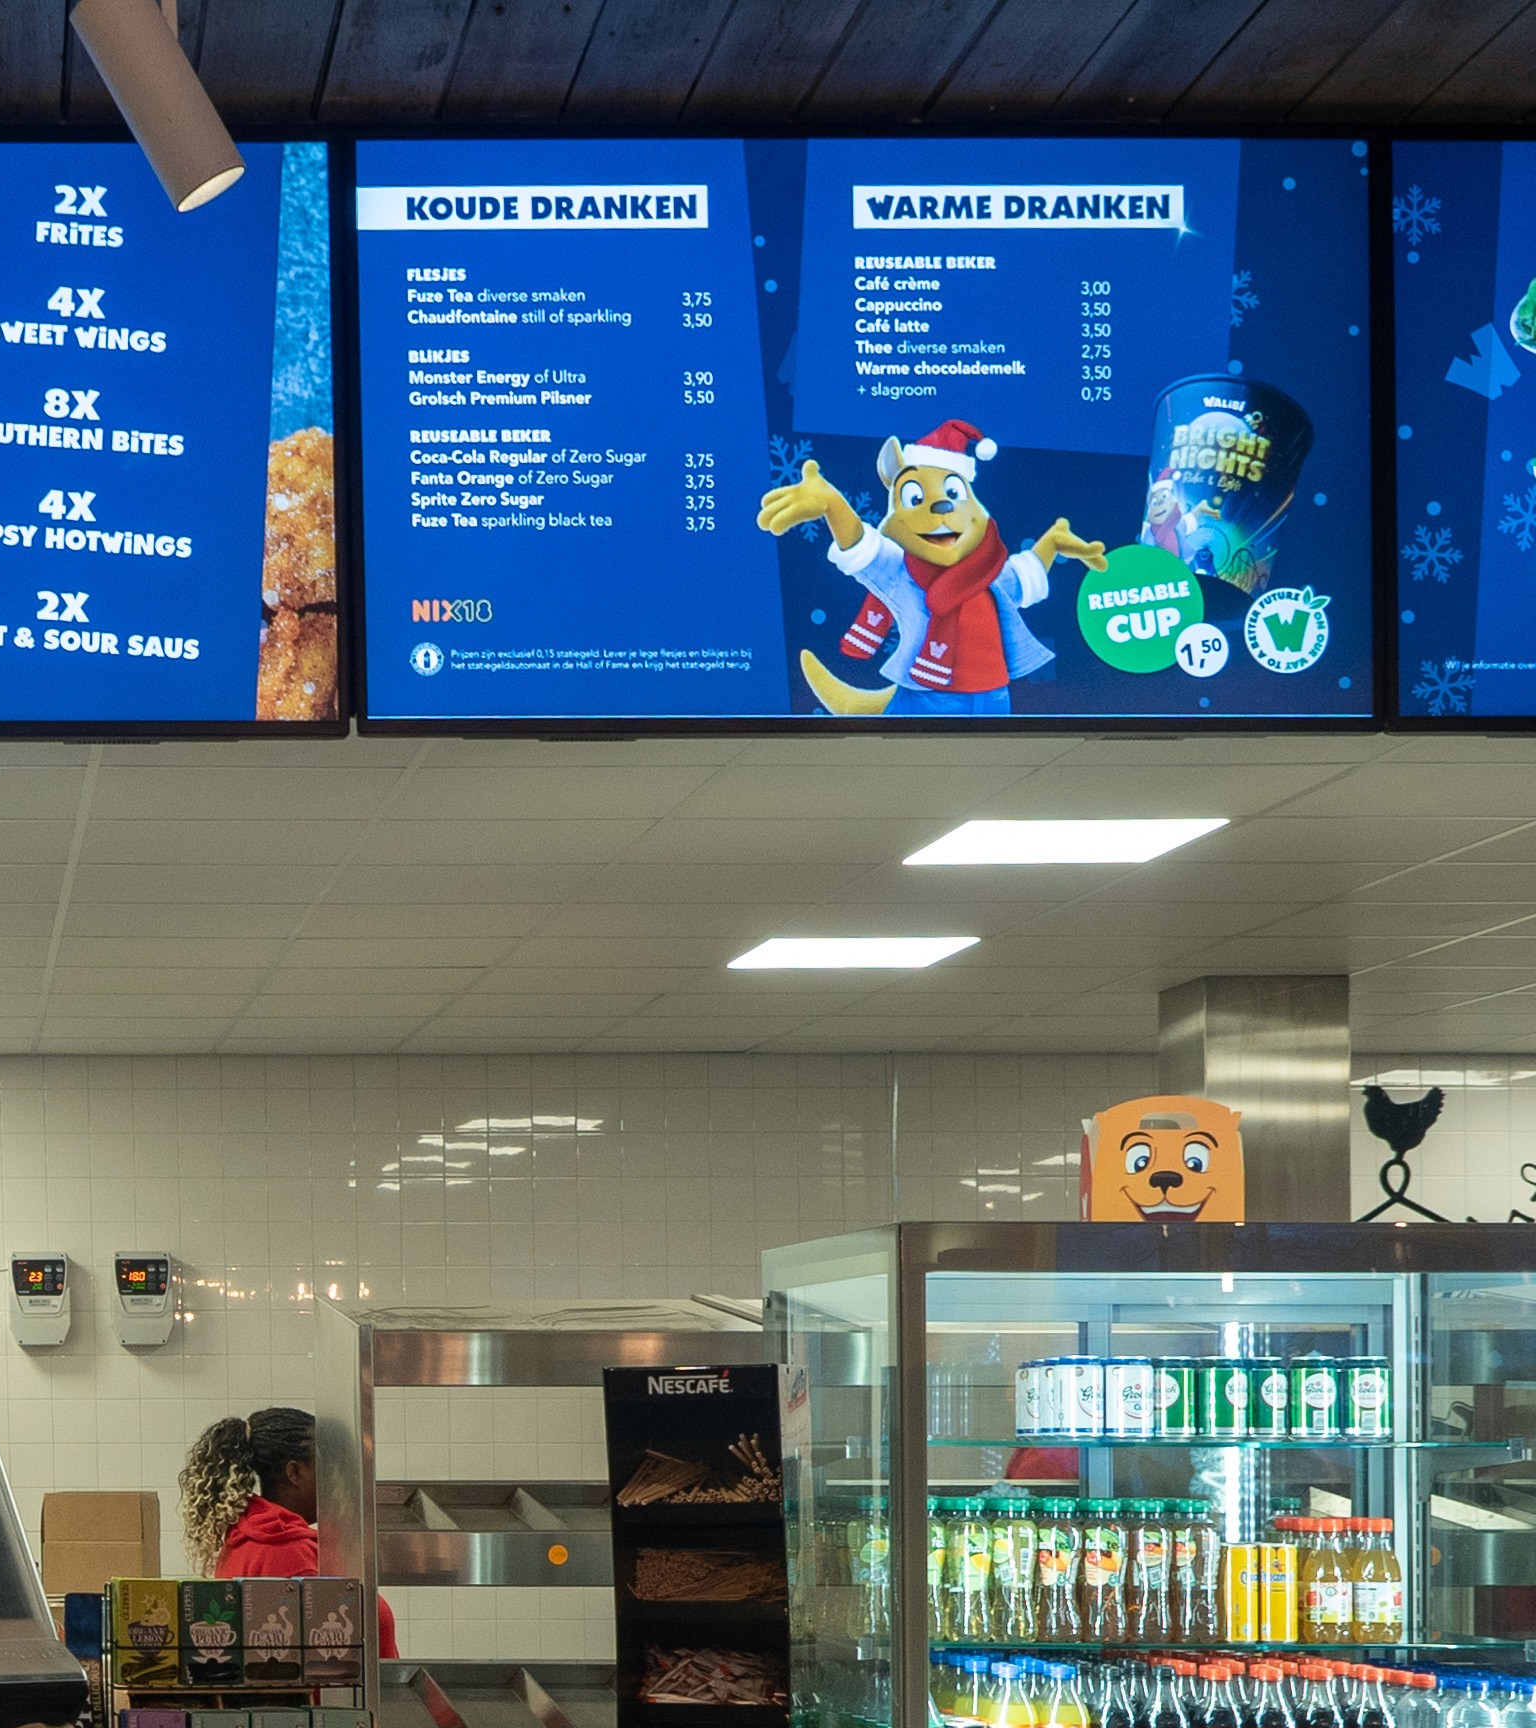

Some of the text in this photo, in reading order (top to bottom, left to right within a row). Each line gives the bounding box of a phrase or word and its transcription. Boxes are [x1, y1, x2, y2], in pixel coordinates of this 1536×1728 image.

[55, 185, 107, 217] 2X
[407, 194, 697, 220] KOUDE DRANKEN
[867, 194, 1170, 220] WARME DRANKEN
[855, 256, 996, 269] REUSEABLE BEKER
[855, 276, 1110, 296] Café crème 3,00
[48, 287, 105, 319] 4X
[408, 288, 711, 307] Fuze Tea diverse smaken 3,75
[855, 298, 1110, 316] Cappuccino 3,50
[408, 309, 712, 328] Chaudfontaine still of sparkling 3,50
[855, 318, 1110, 338] Café latte 3,50
[855, 340, 1110, 359] Thee diverse smaken 2,75
[409, 369, 713, 387] Monster Energy of Ultra 3,90
[856, 361, 1111, 380] Warme chocolademelk 3,50
[409, 390, 714, 405] Grolsch Premium Pilsner 5,50
[871, 382, 936, 400] slagroom
[1081, 387, 1111, 402] 0,75
[44, 389, 100, 420] 8X
[410, 429, 551, 443] REUSEABLE BEKER
[410, 449, 714, 468] Coca-Cola Regular of Zero Sugar 3,75
[411, 470, 714, 489] Fanta Orange of Zero Sugar 3,75
[39, 490, 96, 521] 4X
[411, 492, 714, 511] Sprite Zero Sugar 3,75
[412, 513, 715, 532] Fuze Tea sparkling black tea 3,75
[1088, 581, 1190, 610] REUSABLE
[1259, 590, 1301, 608] FUTURE
[37, 591, 89, 622] 2X
[1106, 608, 1180, 643] CUP
[1314, 610, 1326, 629] ON
[1250, 609, 1260, 650] BETTER
[14, 627, 34, 649] &
[44, 629, 119, 654] SOUR
[128, 635, 199, 659] SAUS
[1309, 630, 1325, 658] OUR
[1284, 656, 1308, 670] WAY
